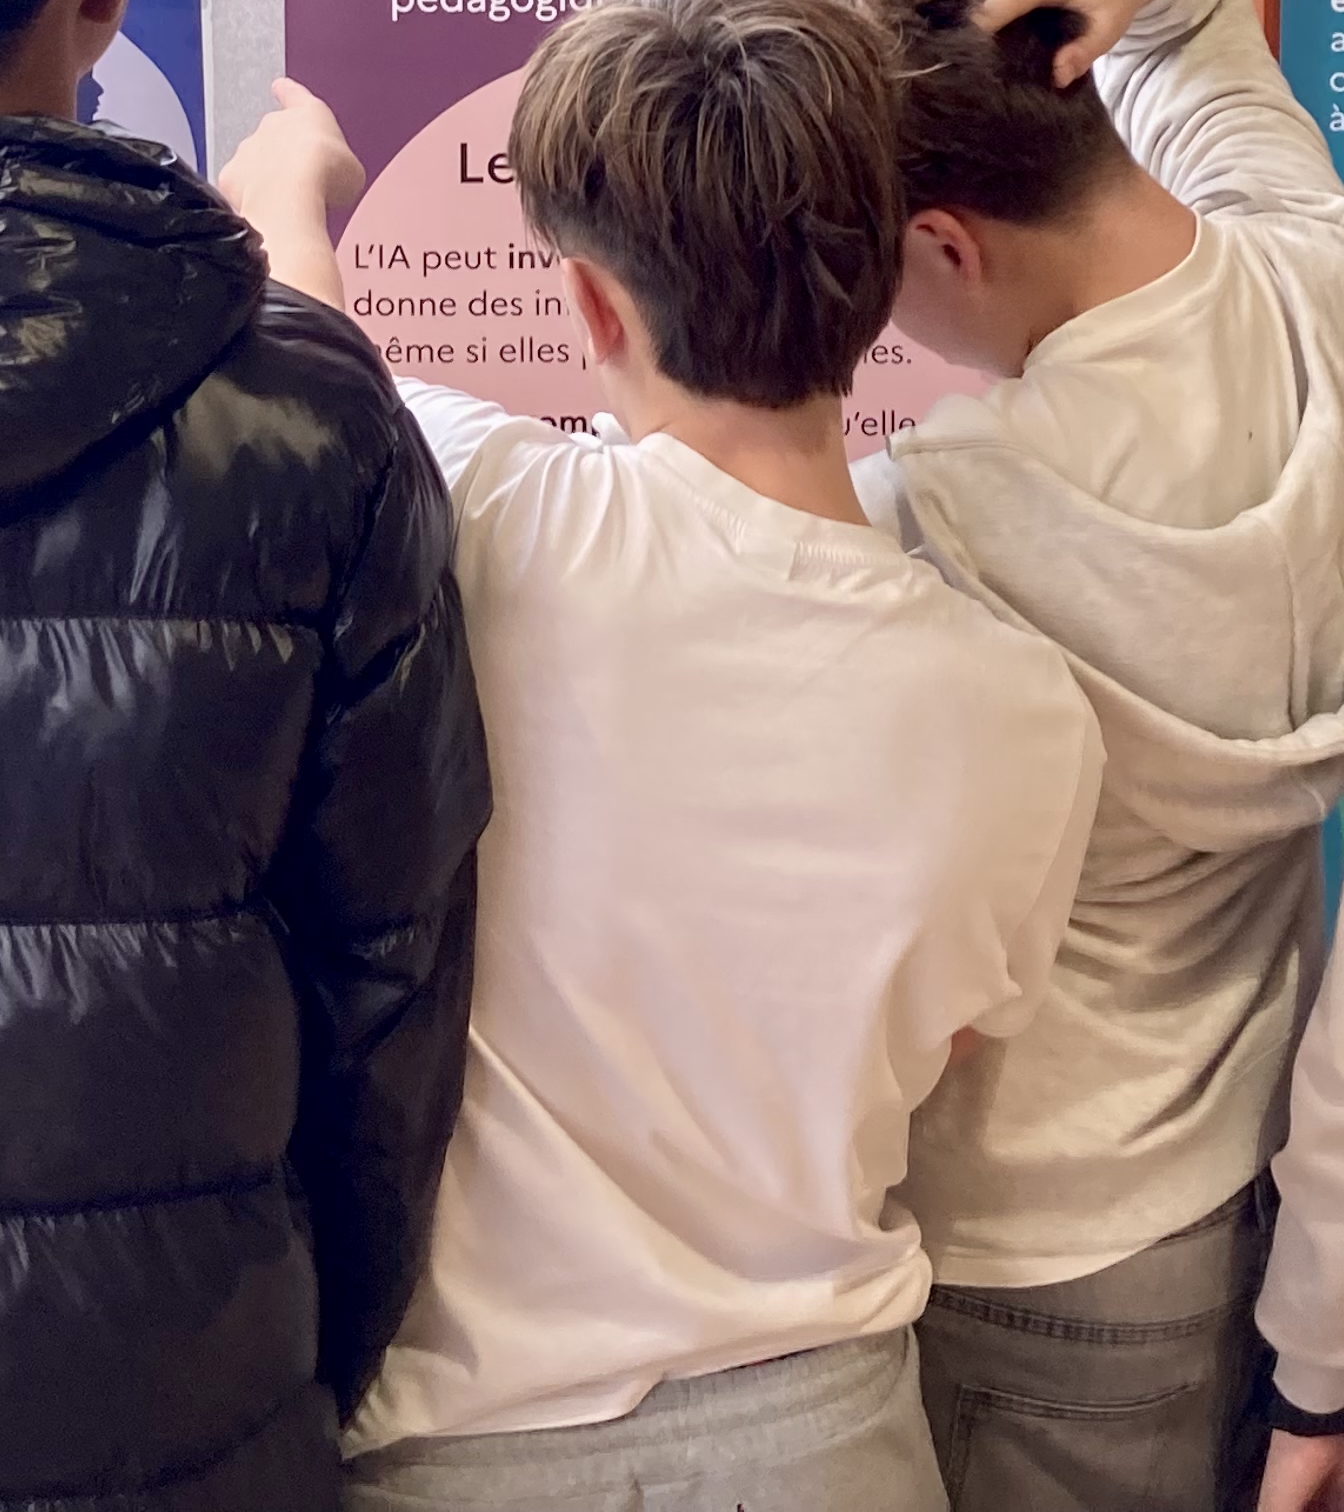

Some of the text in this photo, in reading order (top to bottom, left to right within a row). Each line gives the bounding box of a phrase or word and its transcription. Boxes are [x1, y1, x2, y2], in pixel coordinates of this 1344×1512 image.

[1330, 104, 1344, 131] à
[356, 244, 496, 278] L'IA peut
[354, 289, 456, 316] donne
[468, 290, 522, 316] des
[500, 336, 569, 363] elles
